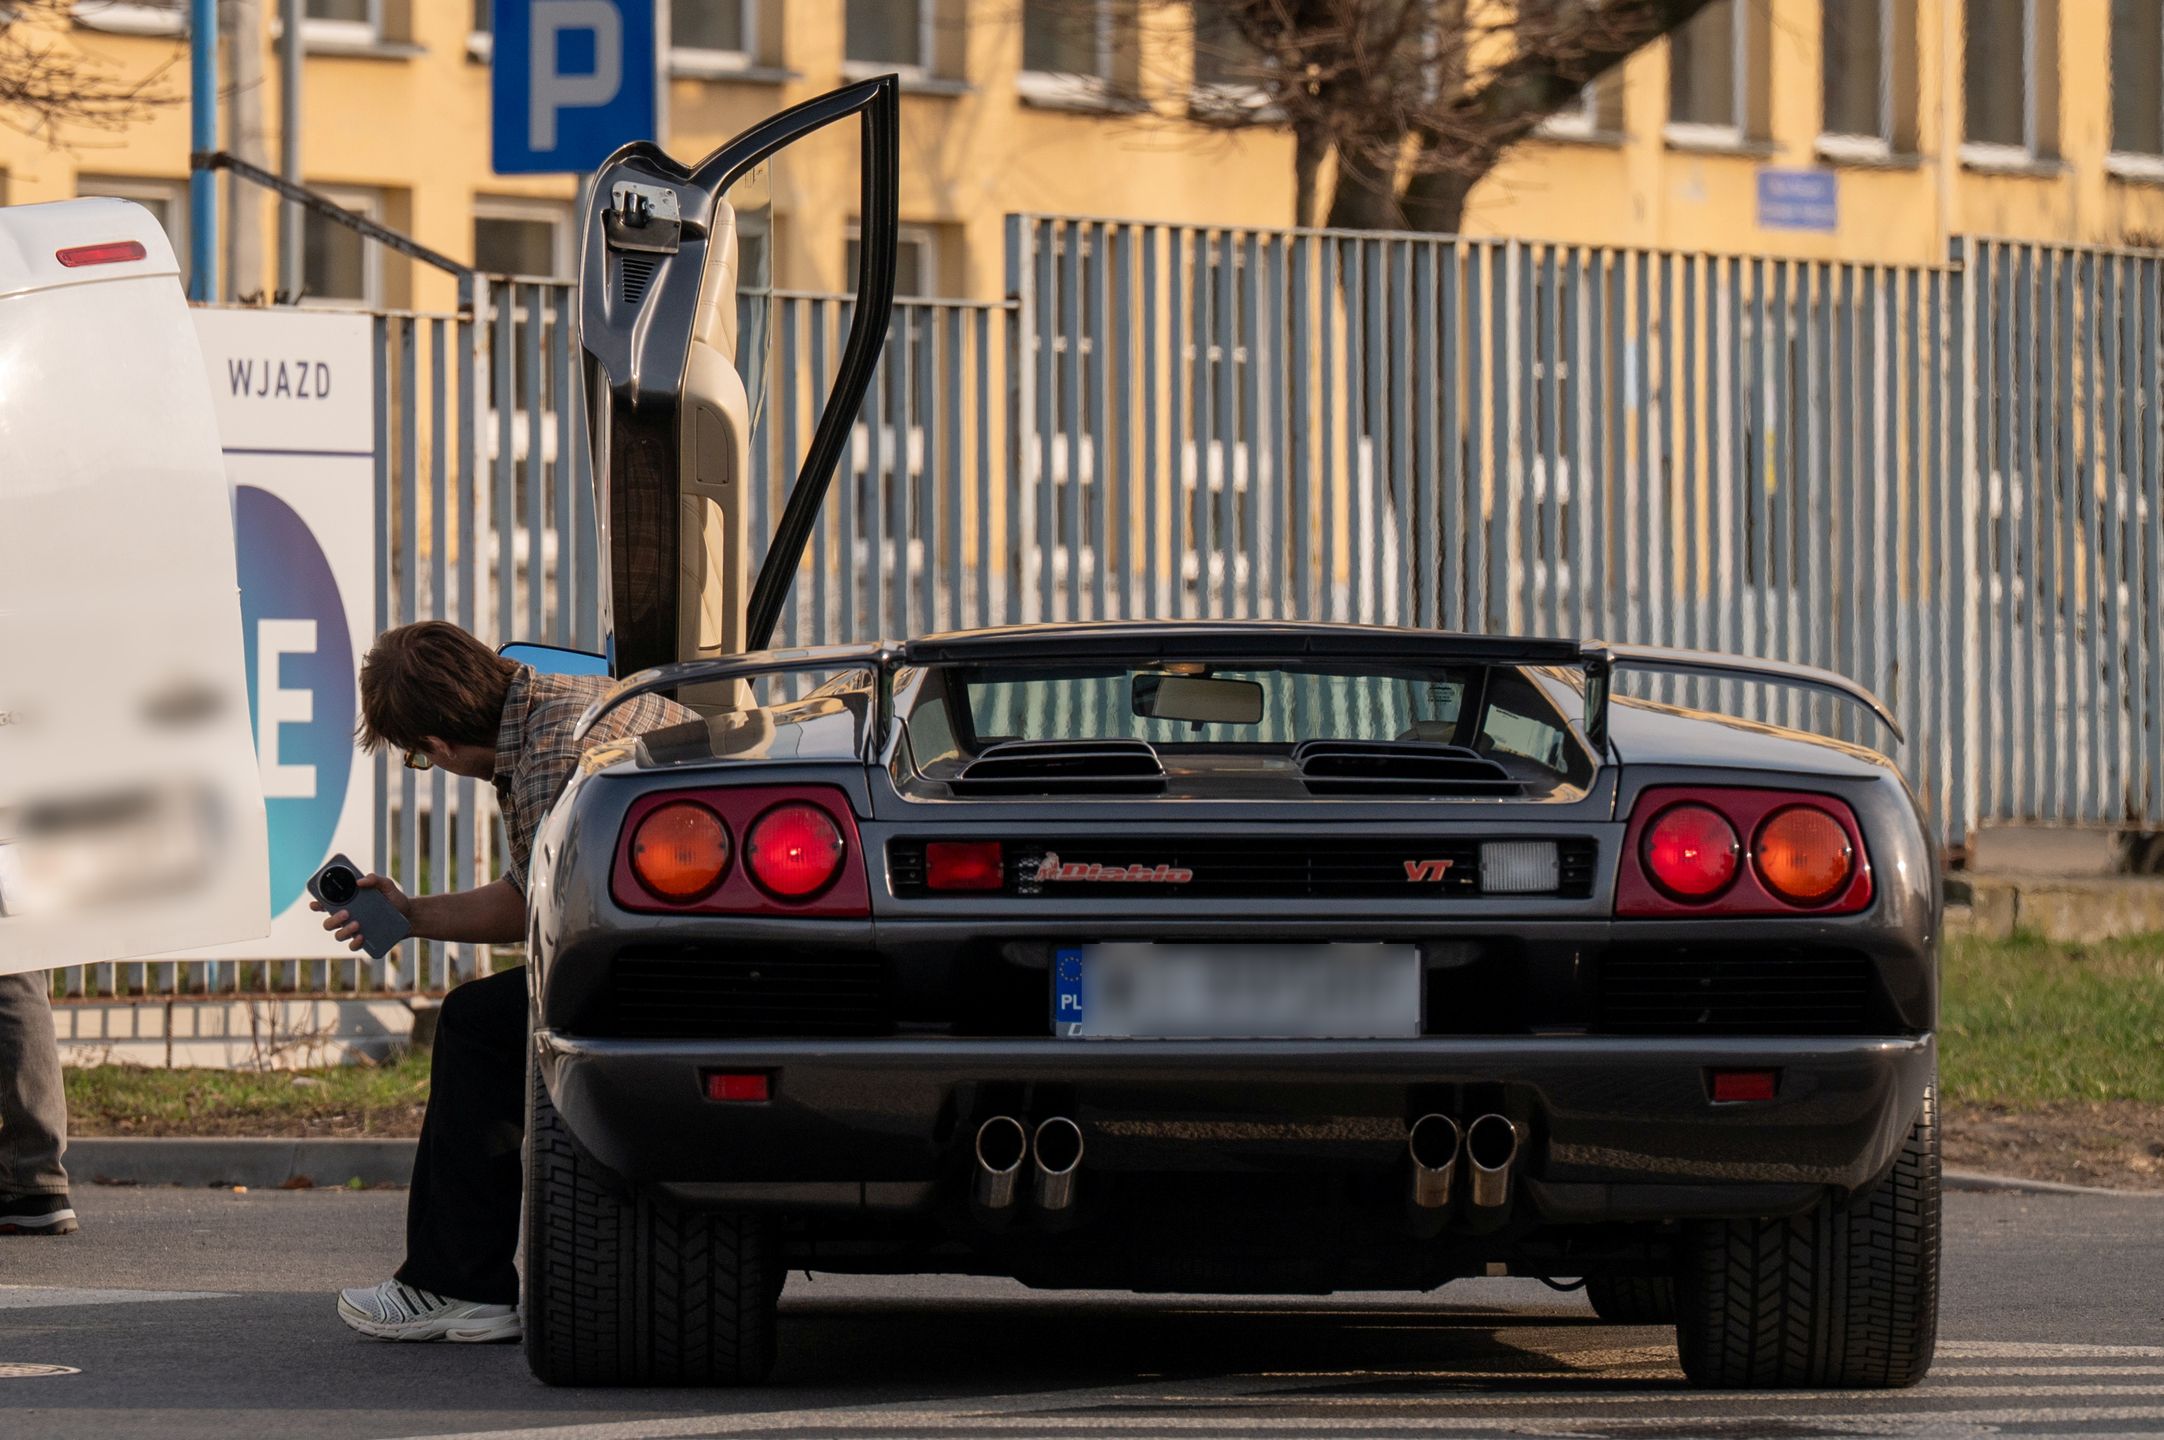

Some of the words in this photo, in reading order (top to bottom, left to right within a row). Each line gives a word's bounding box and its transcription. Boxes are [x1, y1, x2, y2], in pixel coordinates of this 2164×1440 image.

[529, 0, 623, 151] P
[227, 358, 331, 399] WJAZD
[1057, 862, 1193, 883] Diablo
[1403, 860, 1454, 882] VT
[1061, 994, 1082, 1010] PL
